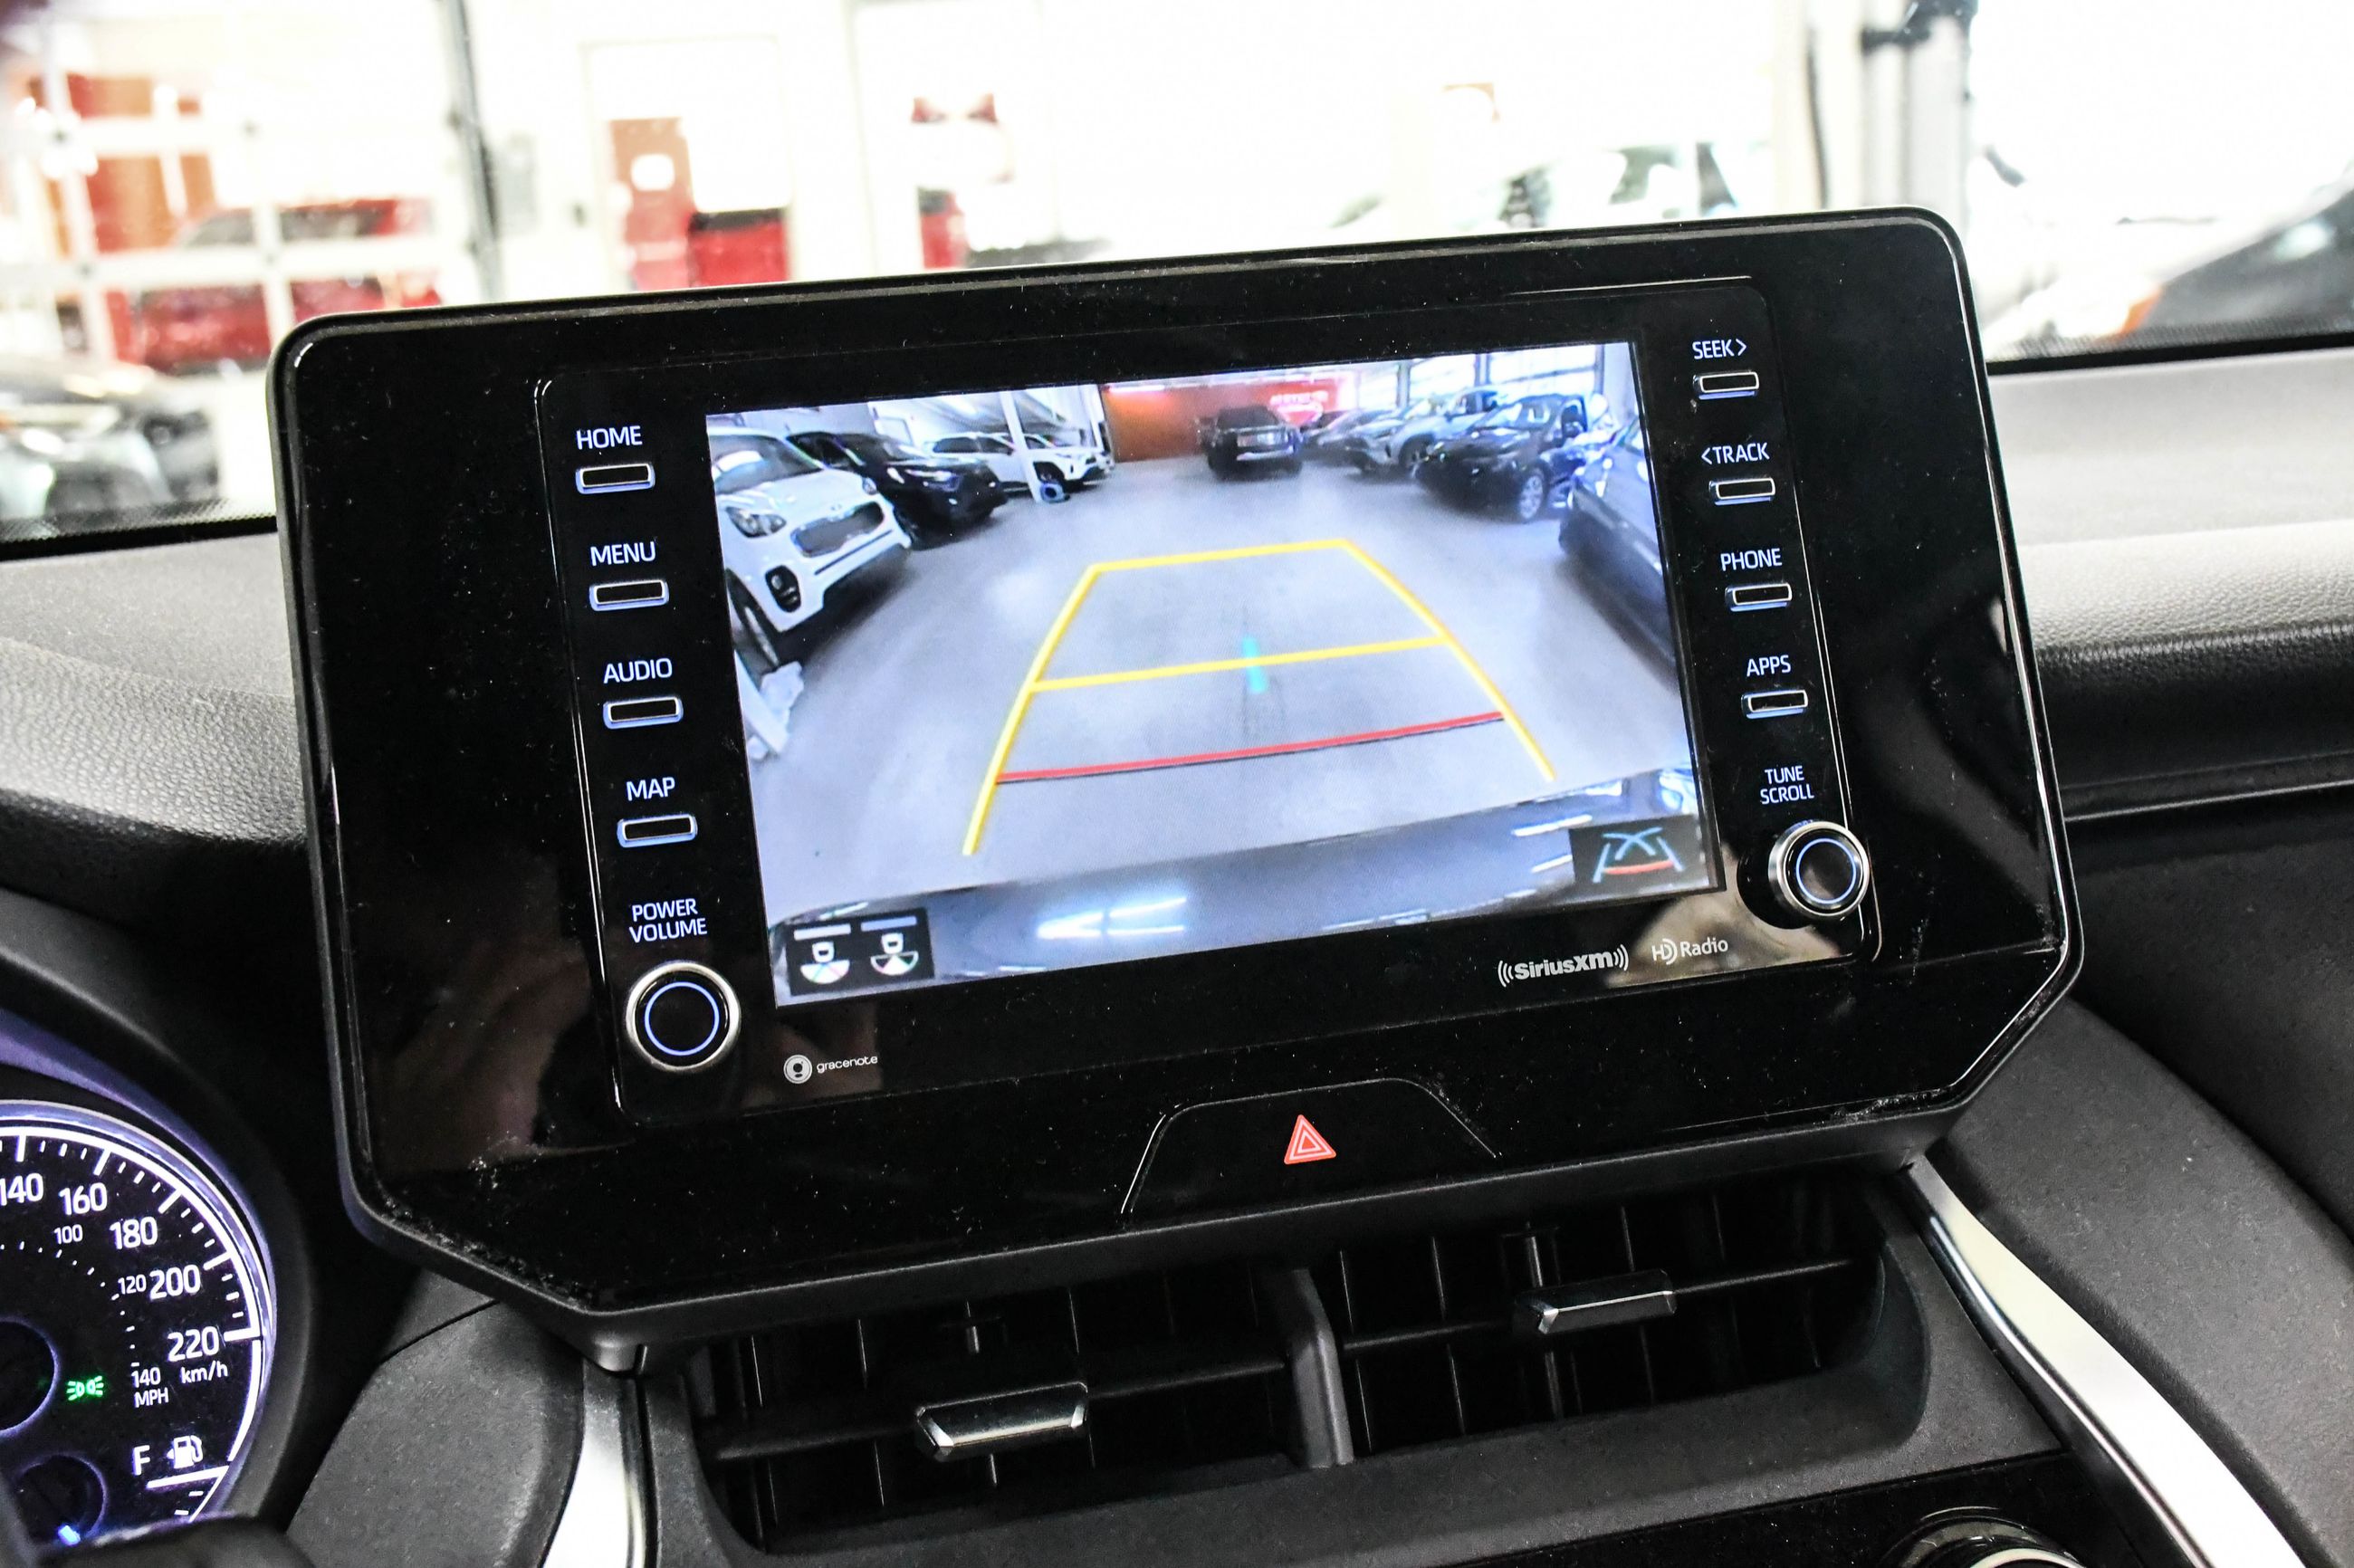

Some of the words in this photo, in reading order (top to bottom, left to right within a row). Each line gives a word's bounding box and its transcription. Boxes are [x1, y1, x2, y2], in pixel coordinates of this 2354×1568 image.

[1692, 339, 1735, 359] SEEK
[576, 425, 643, 450] HOME
[1712, 443, 1770, 464] TRACK
[590, 541, 656, 566] MENU
[1720, 548, 1783, 571] PHONE
[603, 658, 673, 684] AUDIO
[1746, 655, 1792, 676] APPS
[1765, 766, 1804, 785] TUNE
[627, 777, 676, 801] MAP
[1760, 783, 1814, 805] SCROLL
[632, 898, 698, 922] POWER
[629, 918, 708, 943] VOLUME
[1679, 937, 1728, 958] Radio
[816, 1055, 878, 1074] gracenote
[0, 1173, 43, 1207] 140
[58, 1182, 108, 1216] 160
[53, 1224, 83, 1244] 100
[109, 1217, 158, 1249] 180
[118, 1275, 147, 1295] 120
[148, 1265, 202, 1301] 200
[167, 1325, 220, 1362] 220
[131, 1367, 160, 1388] 140
[180, 1361, 228, 1384] km/h
[134, 1386, 169, 1408] MPH
[132, 1445, 150, 1476] F
